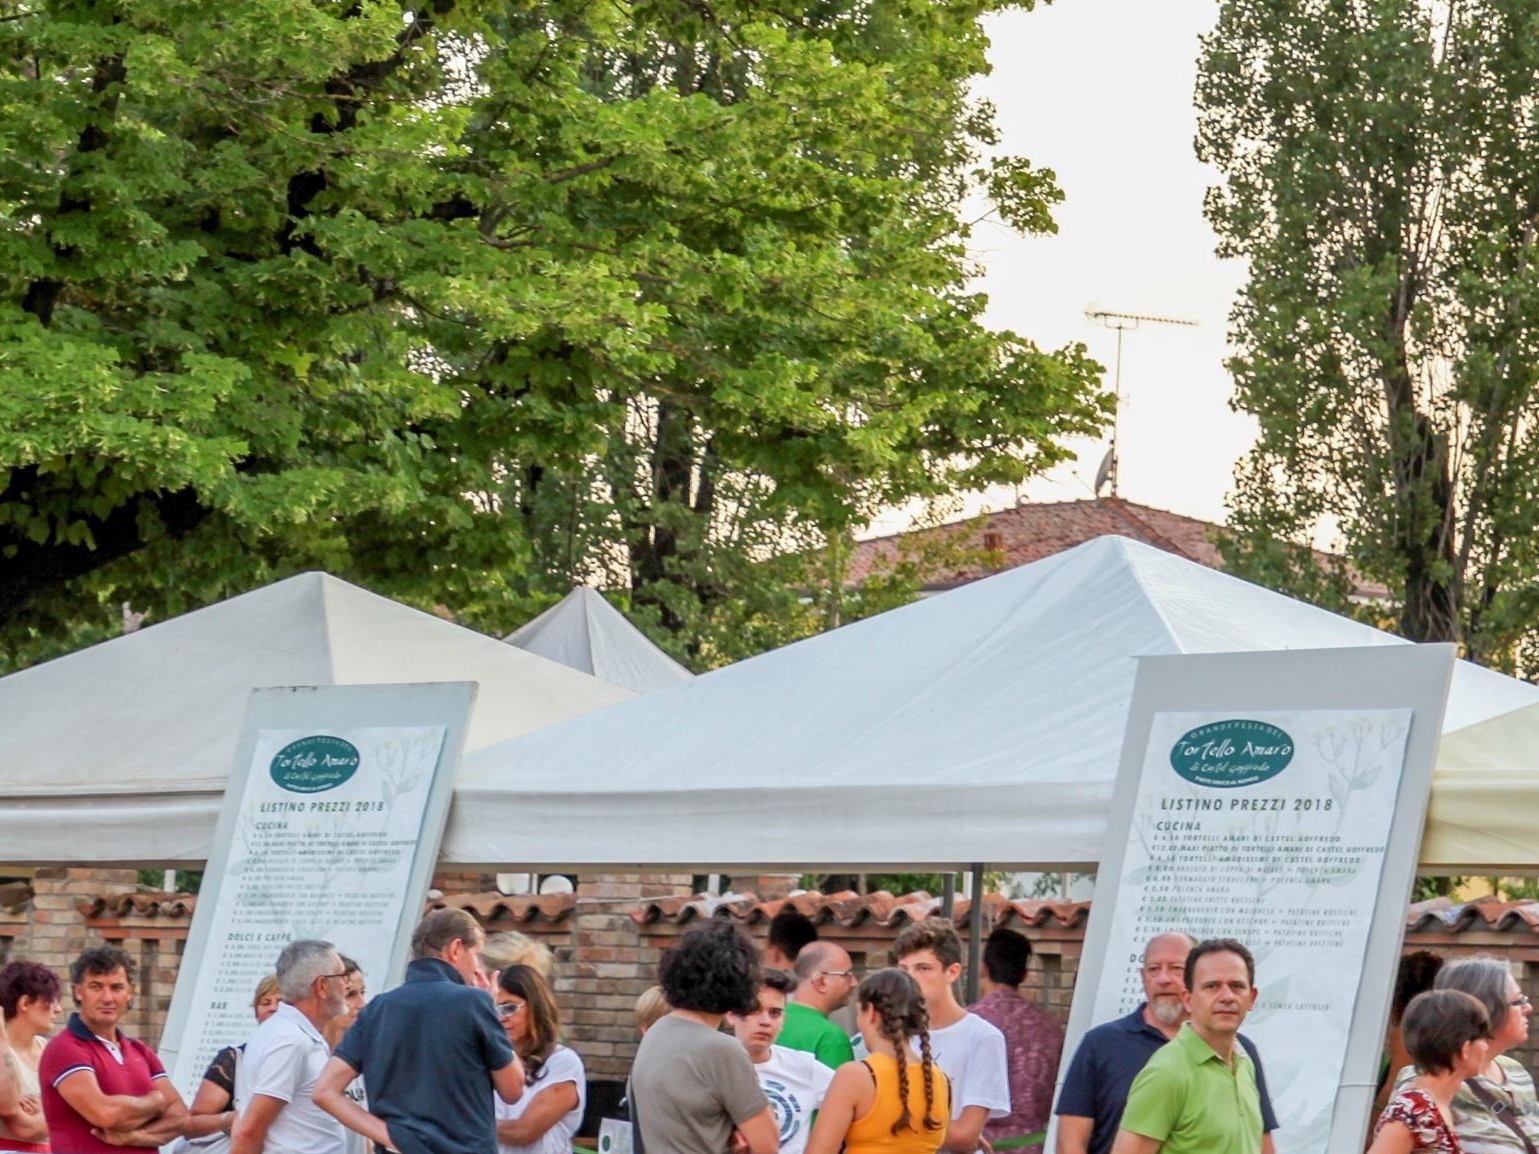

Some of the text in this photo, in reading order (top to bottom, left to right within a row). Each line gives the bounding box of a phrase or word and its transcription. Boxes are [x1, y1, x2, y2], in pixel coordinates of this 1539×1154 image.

[1190, 722, 1282, 739] GRANDE FESTA DEL
[1240, 740, 1292, 758] Amaro
[260, 801, 306, 813] LISTINO
[309, 801, 350, 812] PREZZI
[1160, 798, 1333, 811] LISTINO PREZZI 2018
[255, 821, 289, 830] CUCINA
[1156, 821, 1202, 831] CUCINA
